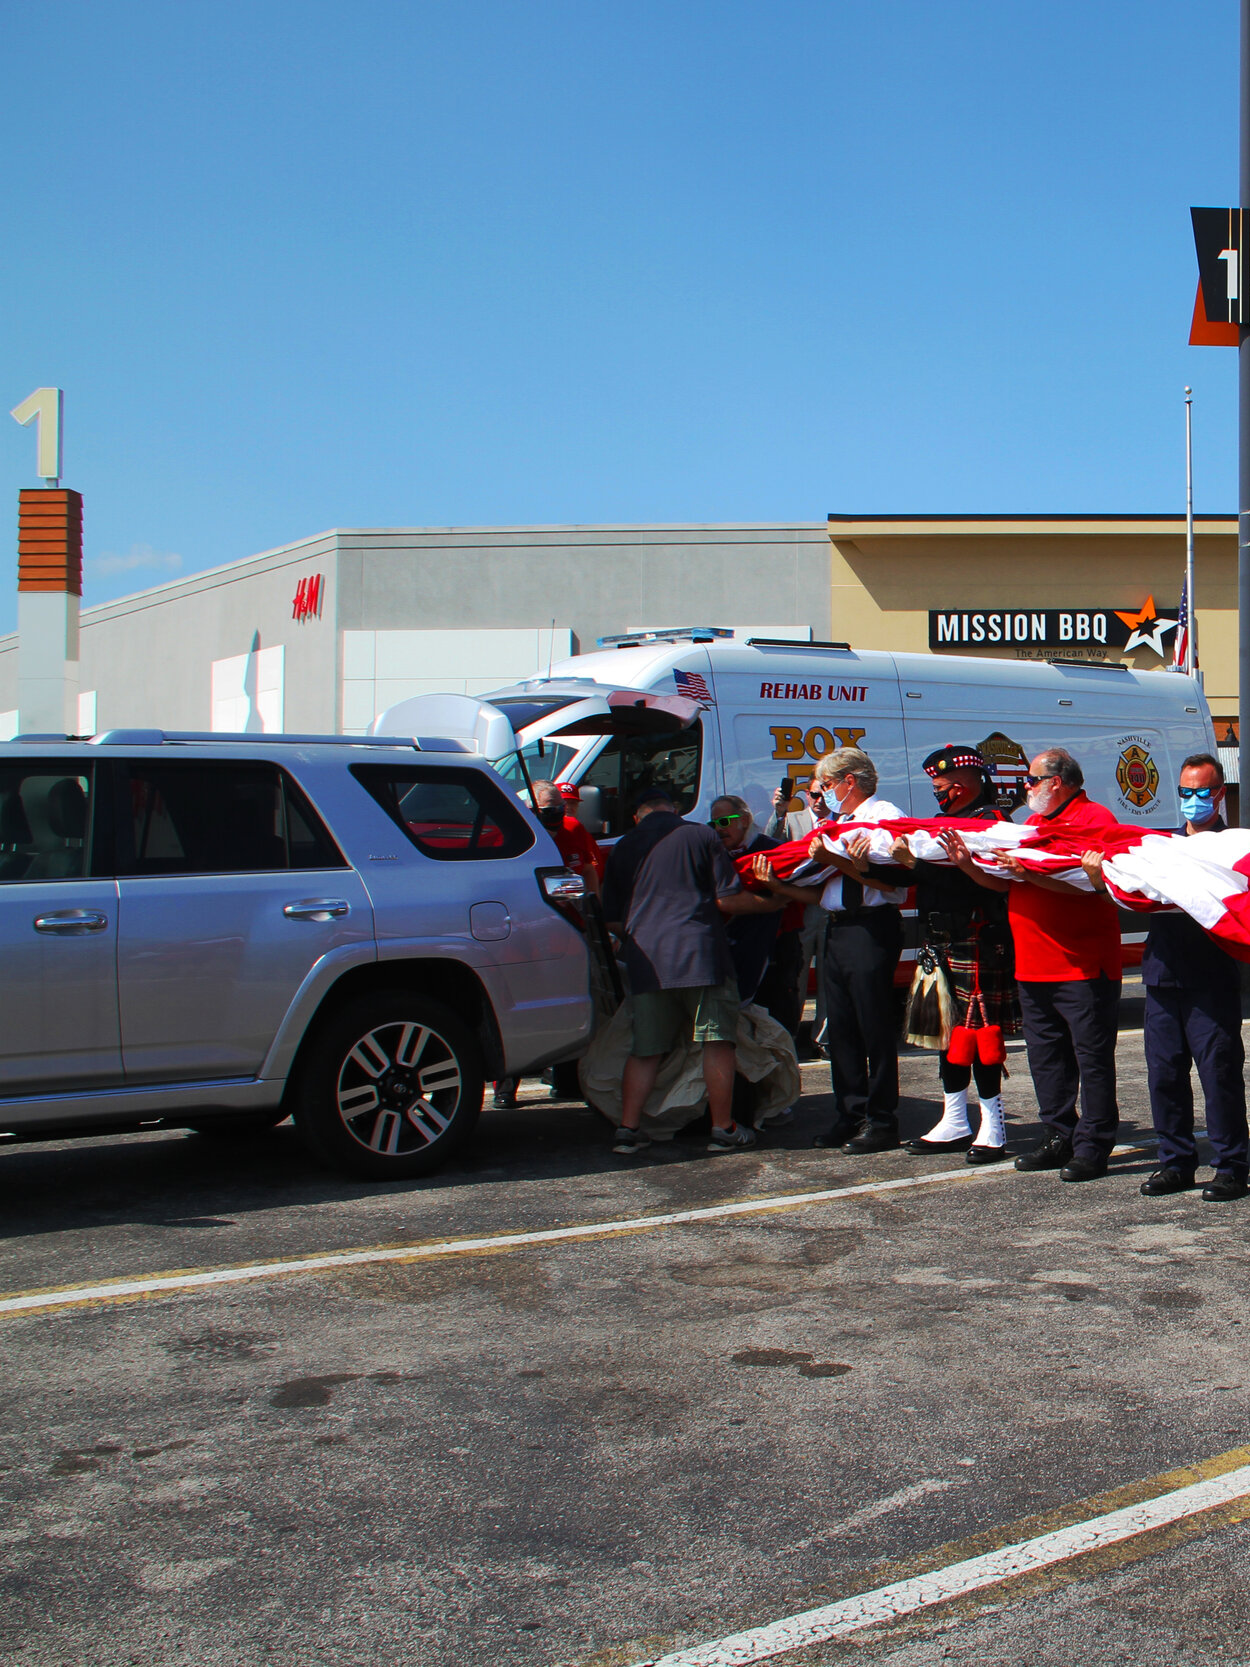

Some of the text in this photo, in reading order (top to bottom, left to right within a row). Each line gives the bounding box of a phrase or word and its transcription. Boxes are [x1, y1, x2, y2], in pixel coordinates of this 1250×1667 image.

[9, 387, 64, 479] 1
[292, 573, 321, 619] H&M
[937, 613, 1108, 644] MISSION BBQ
[1015, 649, 1031, 658] The
[1037, 649, 1083, 658] American
[760, 682, 869, 702] REHAB UNIT
[769, 726, 868, 761] BOX
[1117, 735, 1152, 749] NASHVILLE
[1131, 748, 1140, 758] A
[1150, 769, 1156, 784] F
[1136, 793, 1144, 805] F
